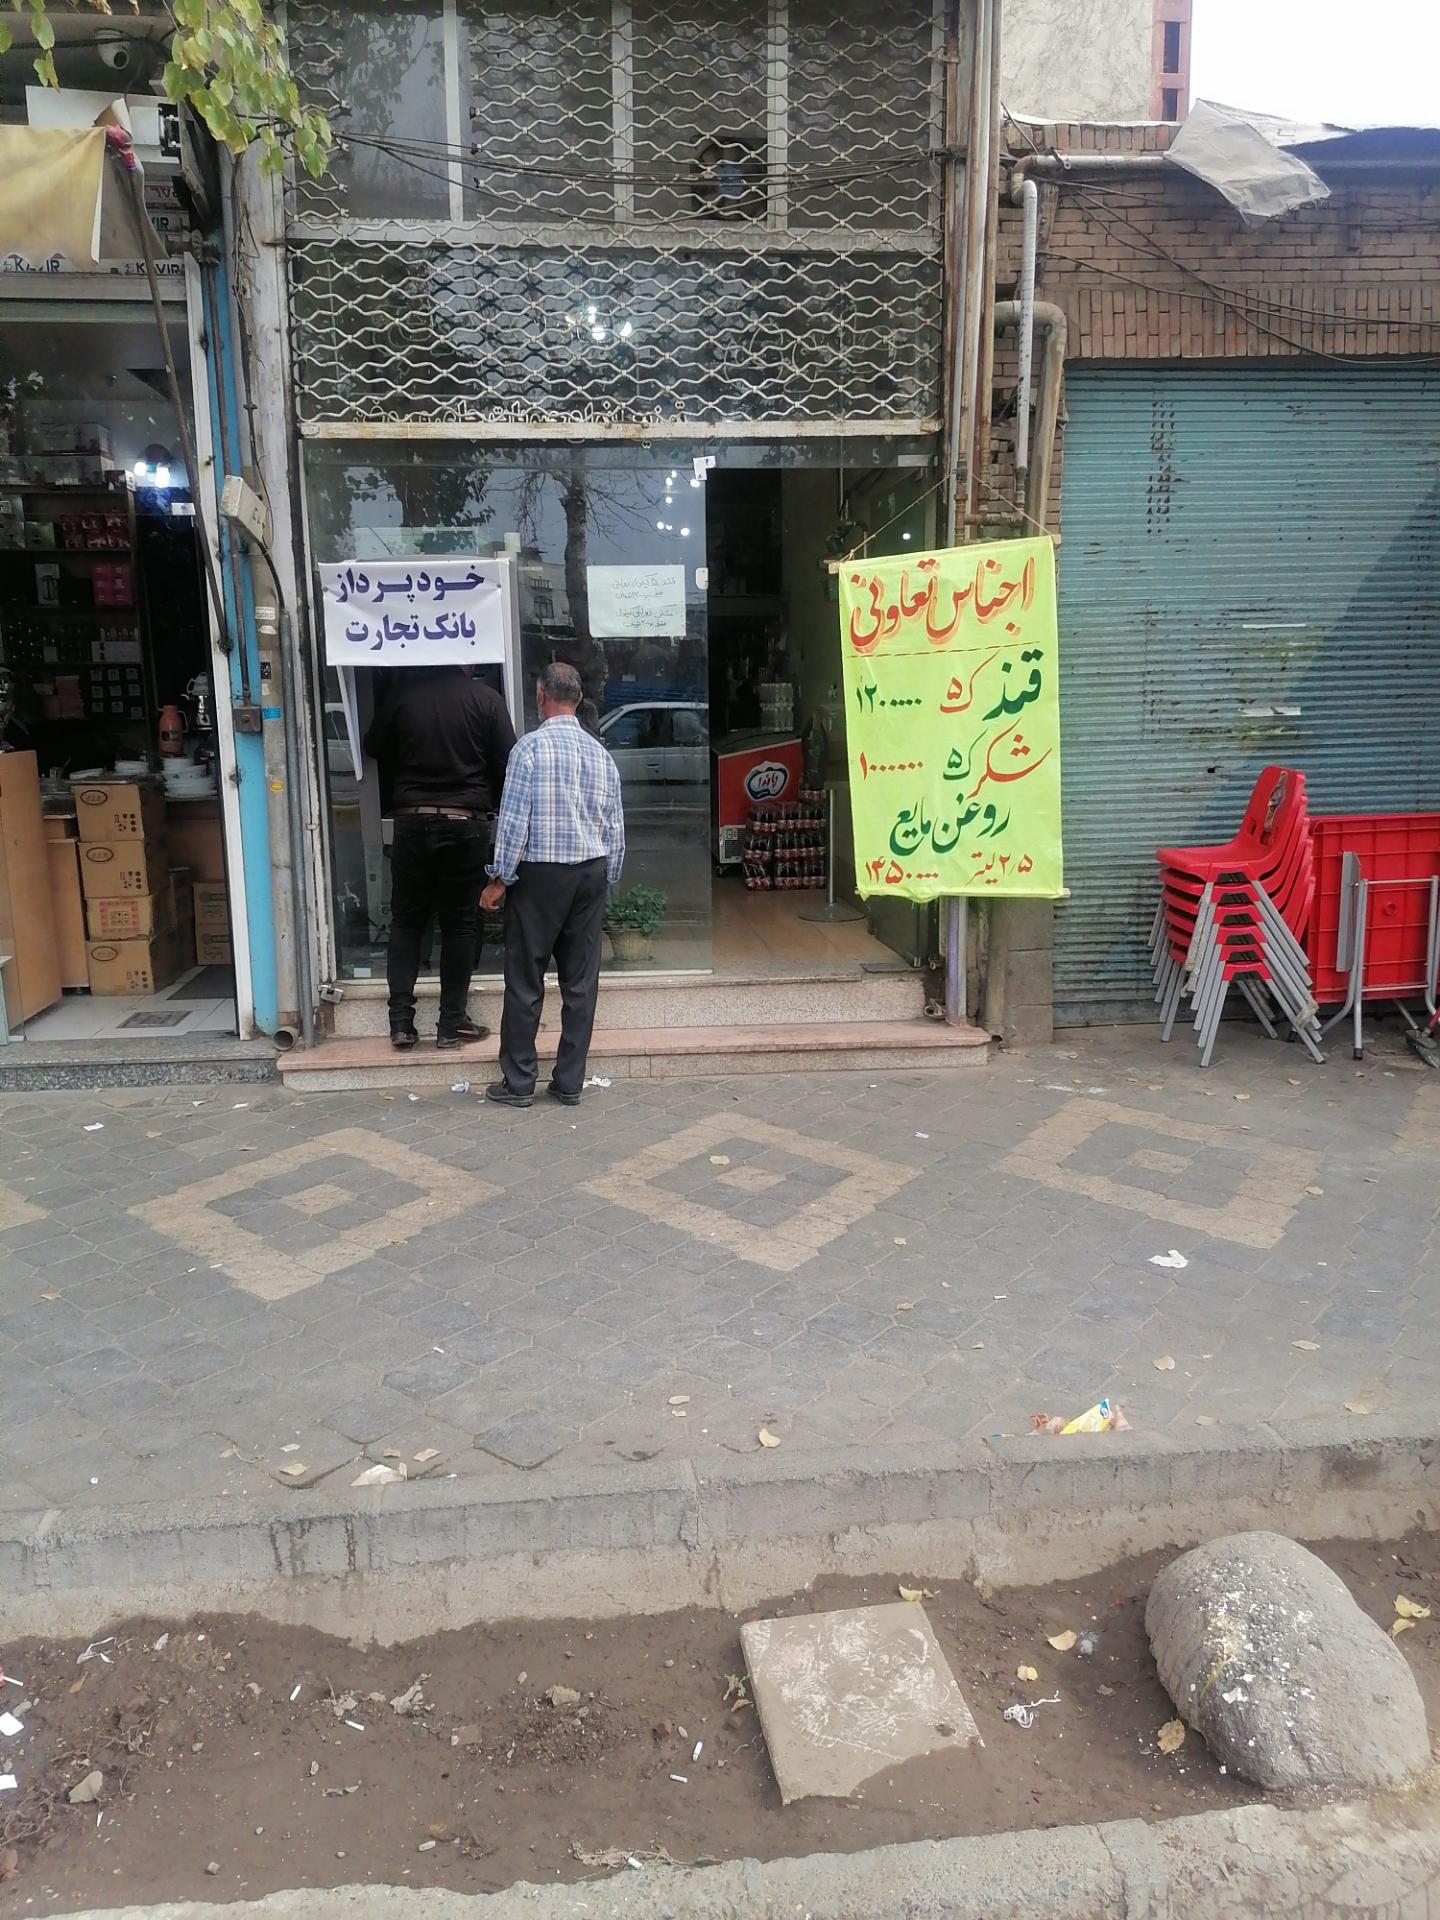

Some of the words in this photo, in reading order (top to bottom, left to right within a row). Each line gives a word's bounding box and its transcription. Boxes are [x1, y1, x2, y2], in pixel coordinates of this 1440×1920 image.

[136, 262, 180, 274] KVIR
[423, 611, 476, 646] بانک
[849, 558, 941, 654] تعاونی
[926, 556, 1036, 645] اجناس
[345, 614, 420, 650] تجارت
[982, 648, 1044, 721] قند
[966, 717, 1053, 800] شکر
[889, 797, 932, 857] مایع
[931, 793, 1011, 854] روغن
[963, 851, 996, 886] لیتر
